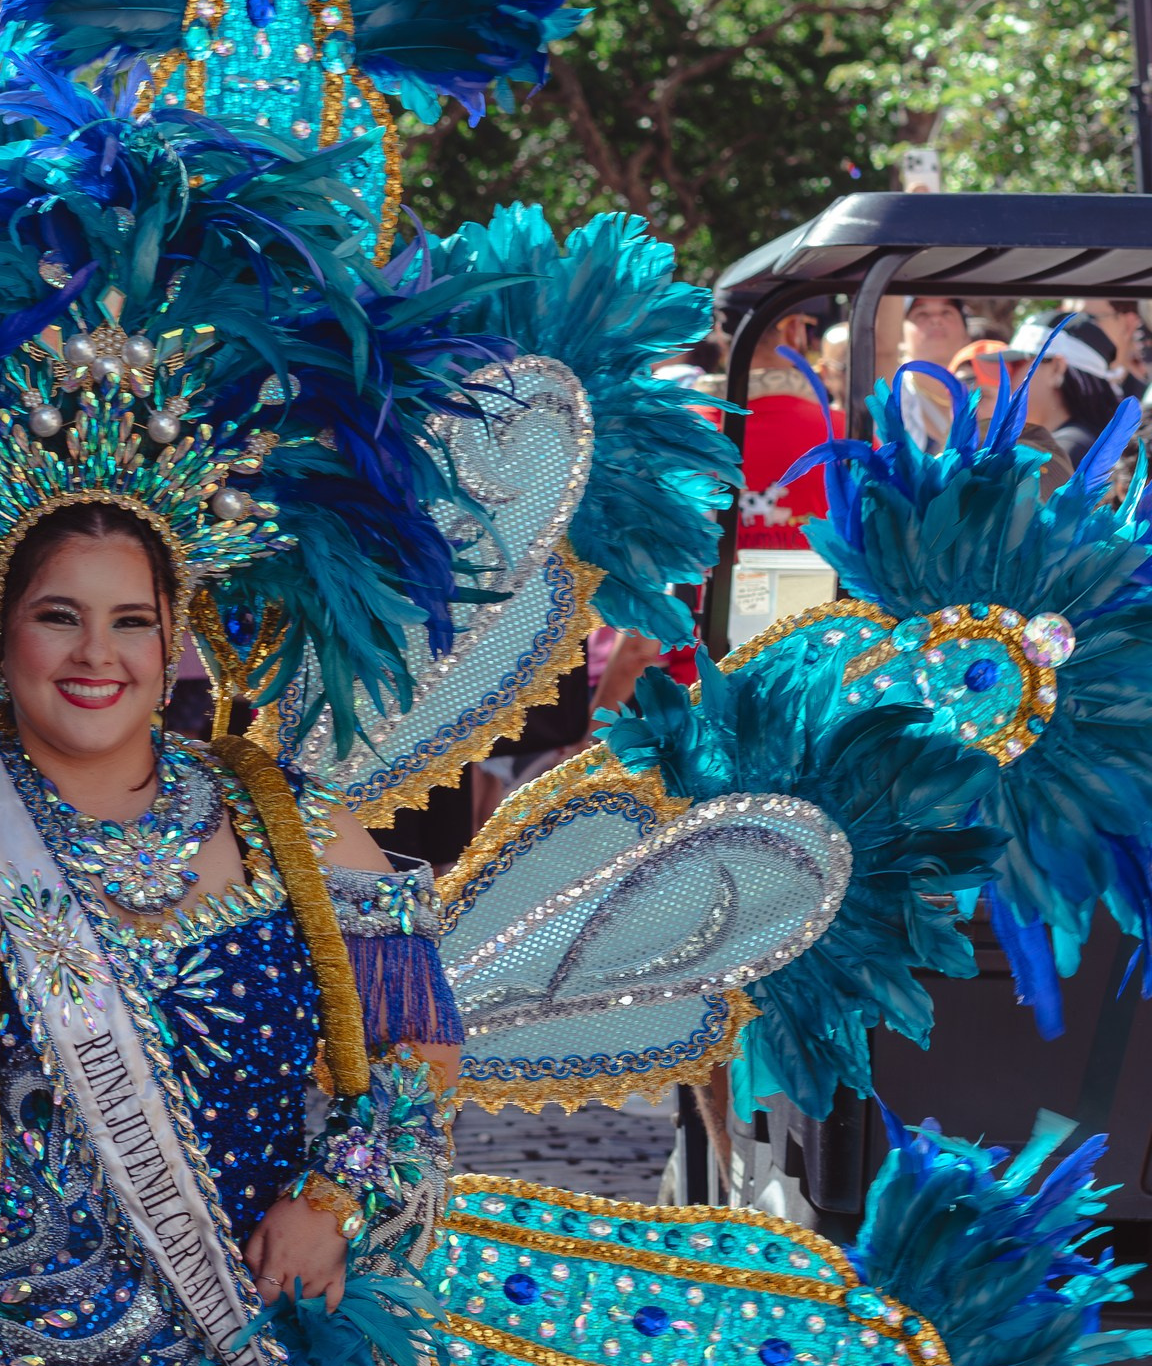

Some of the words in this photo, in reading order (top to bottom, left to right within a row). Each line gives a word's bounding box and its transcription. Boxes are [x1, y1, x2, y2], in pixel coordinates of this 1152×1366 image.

[73, 1029, 137, 1117] REINA
[105, 1109, 182, 1217] JUVENIL
[154, 1211, 234, 1336] CARNAVAL
